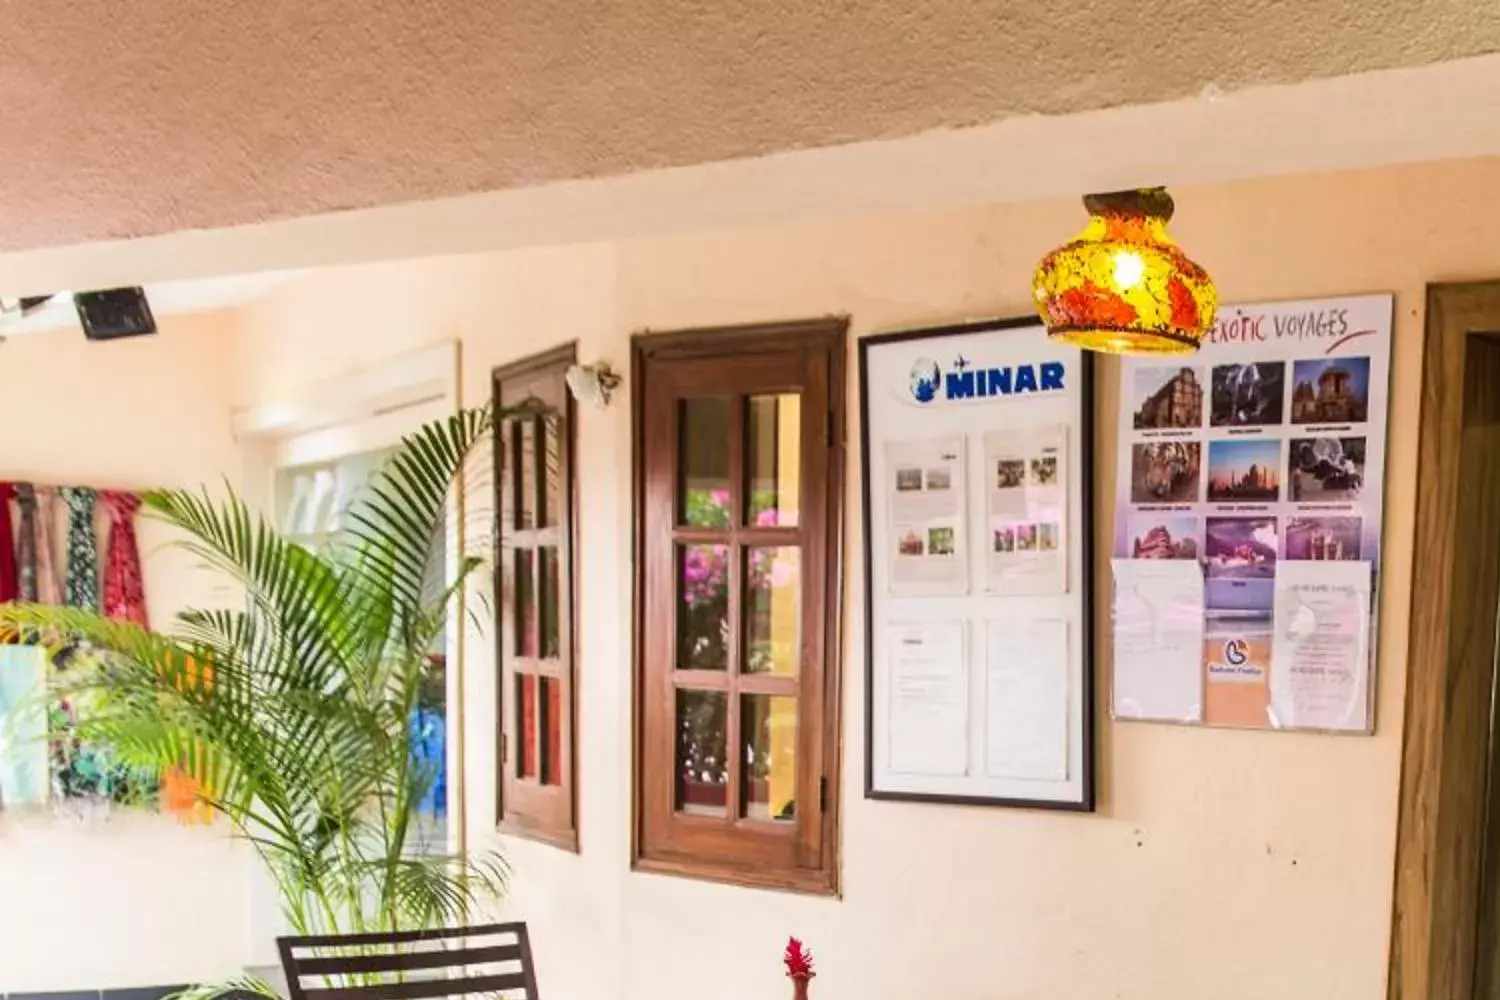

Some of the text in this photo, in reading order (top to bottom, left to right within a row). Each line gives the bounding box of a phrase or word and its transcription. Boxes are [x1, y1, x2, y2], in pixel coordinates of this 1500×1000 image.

[1210, 309, 1349, 343] EXOTIC VOYAGES
[946, 361, 1065, 400] MINAR
